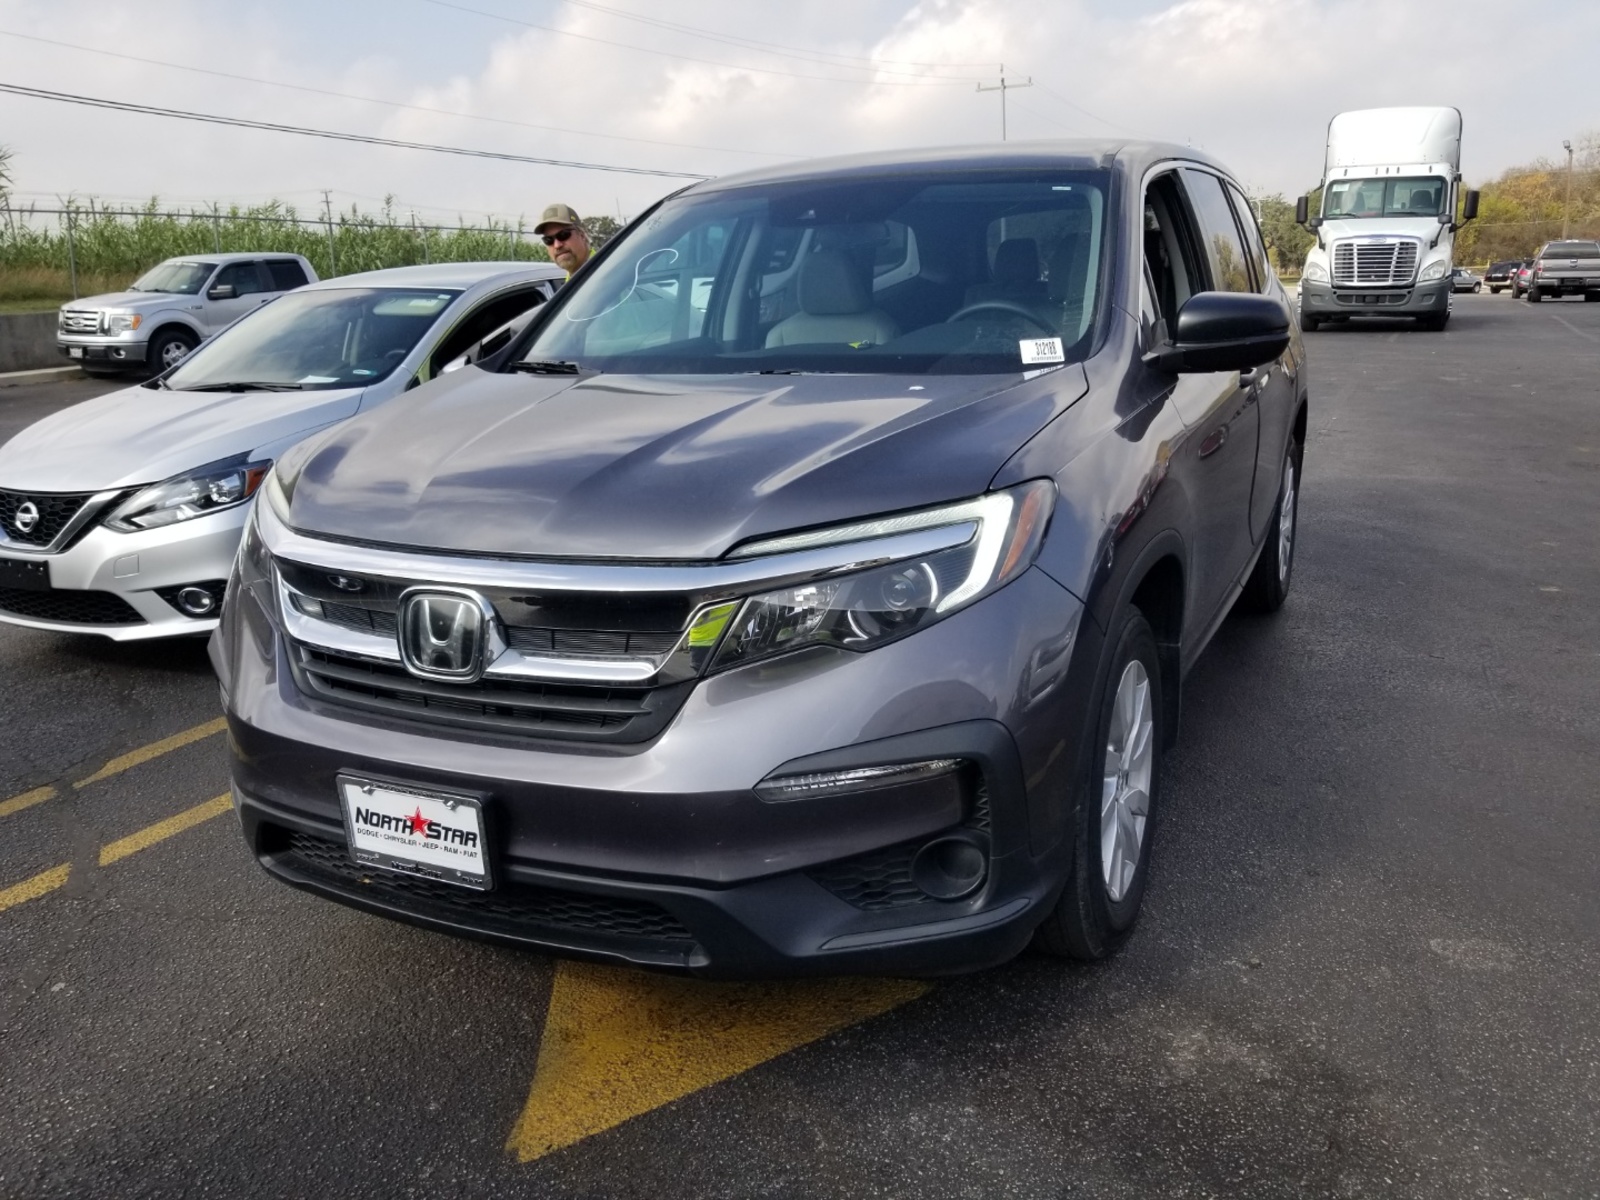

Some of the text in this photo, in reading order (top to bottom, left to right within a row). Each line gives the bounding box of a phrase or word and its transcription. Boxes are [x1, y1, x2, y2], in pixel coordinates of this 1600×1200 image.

[355, 806, 478, 848] NORTH STAR
[357, 827, 478, 859] DODGE CHRYSLER JEEP RAM FIAT
